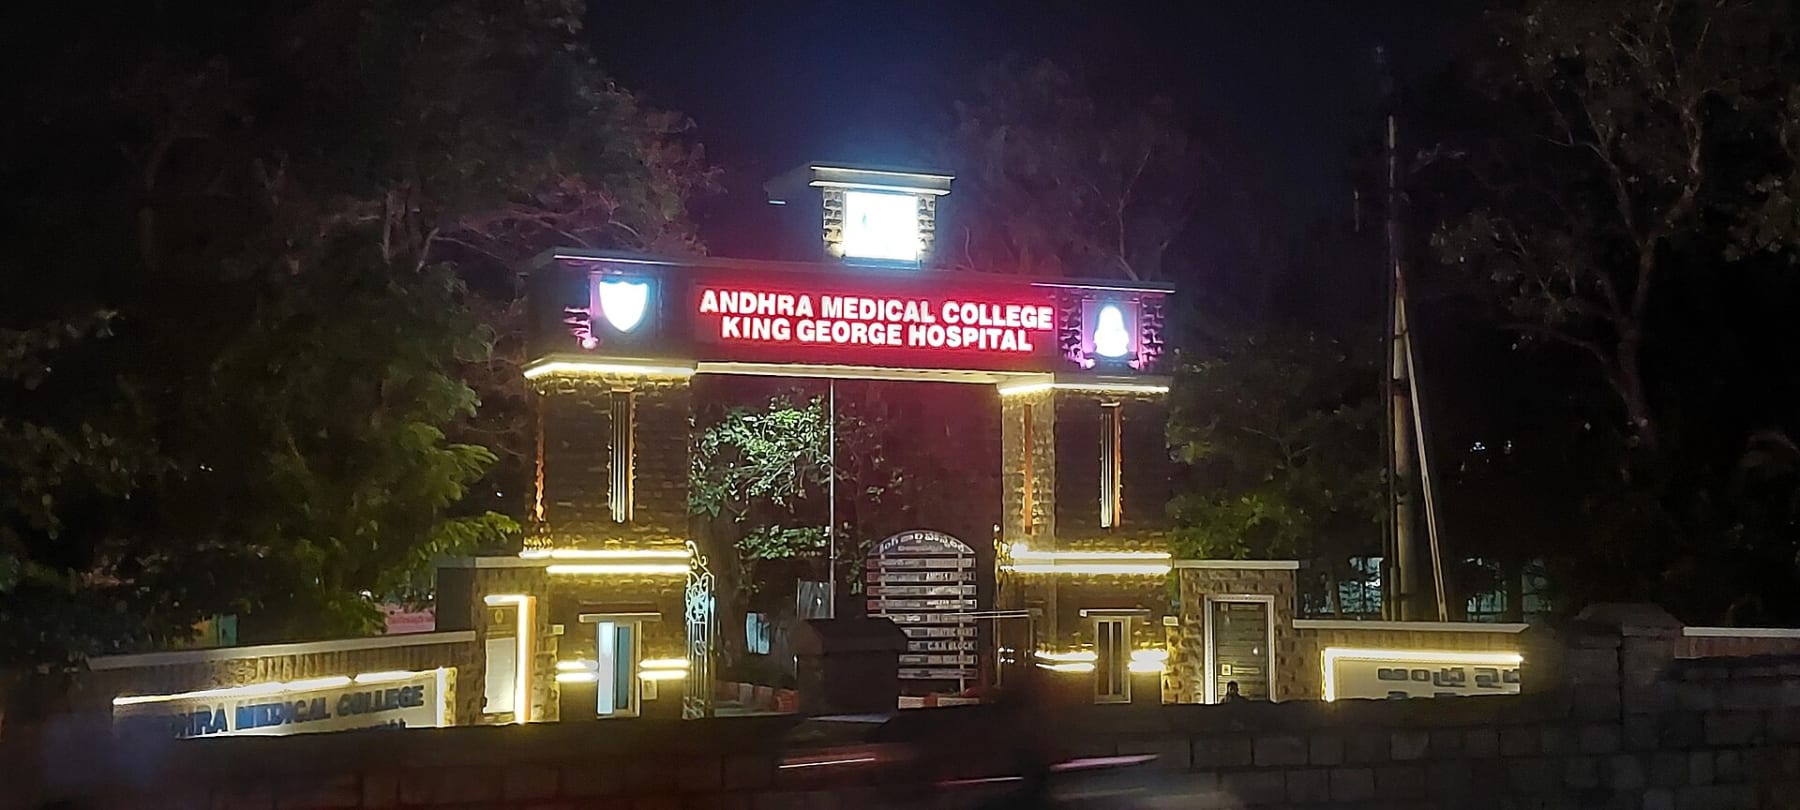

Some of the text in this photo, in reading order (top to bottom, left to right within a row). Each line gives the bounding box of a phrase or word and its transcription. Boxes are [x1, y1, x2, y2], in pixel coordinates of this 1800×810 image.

[699, 289, 1054, 330] ANDHRA MEDICAL COLLEGE
[721, 316, 1034, 352] KING GEORGE HOSPITAL
[1377, 667, 1466, 688] ఆంధ్ర
[235, 697, 331, 730] MEDICAL
[337, 685, 425, 718] COLLEGE
